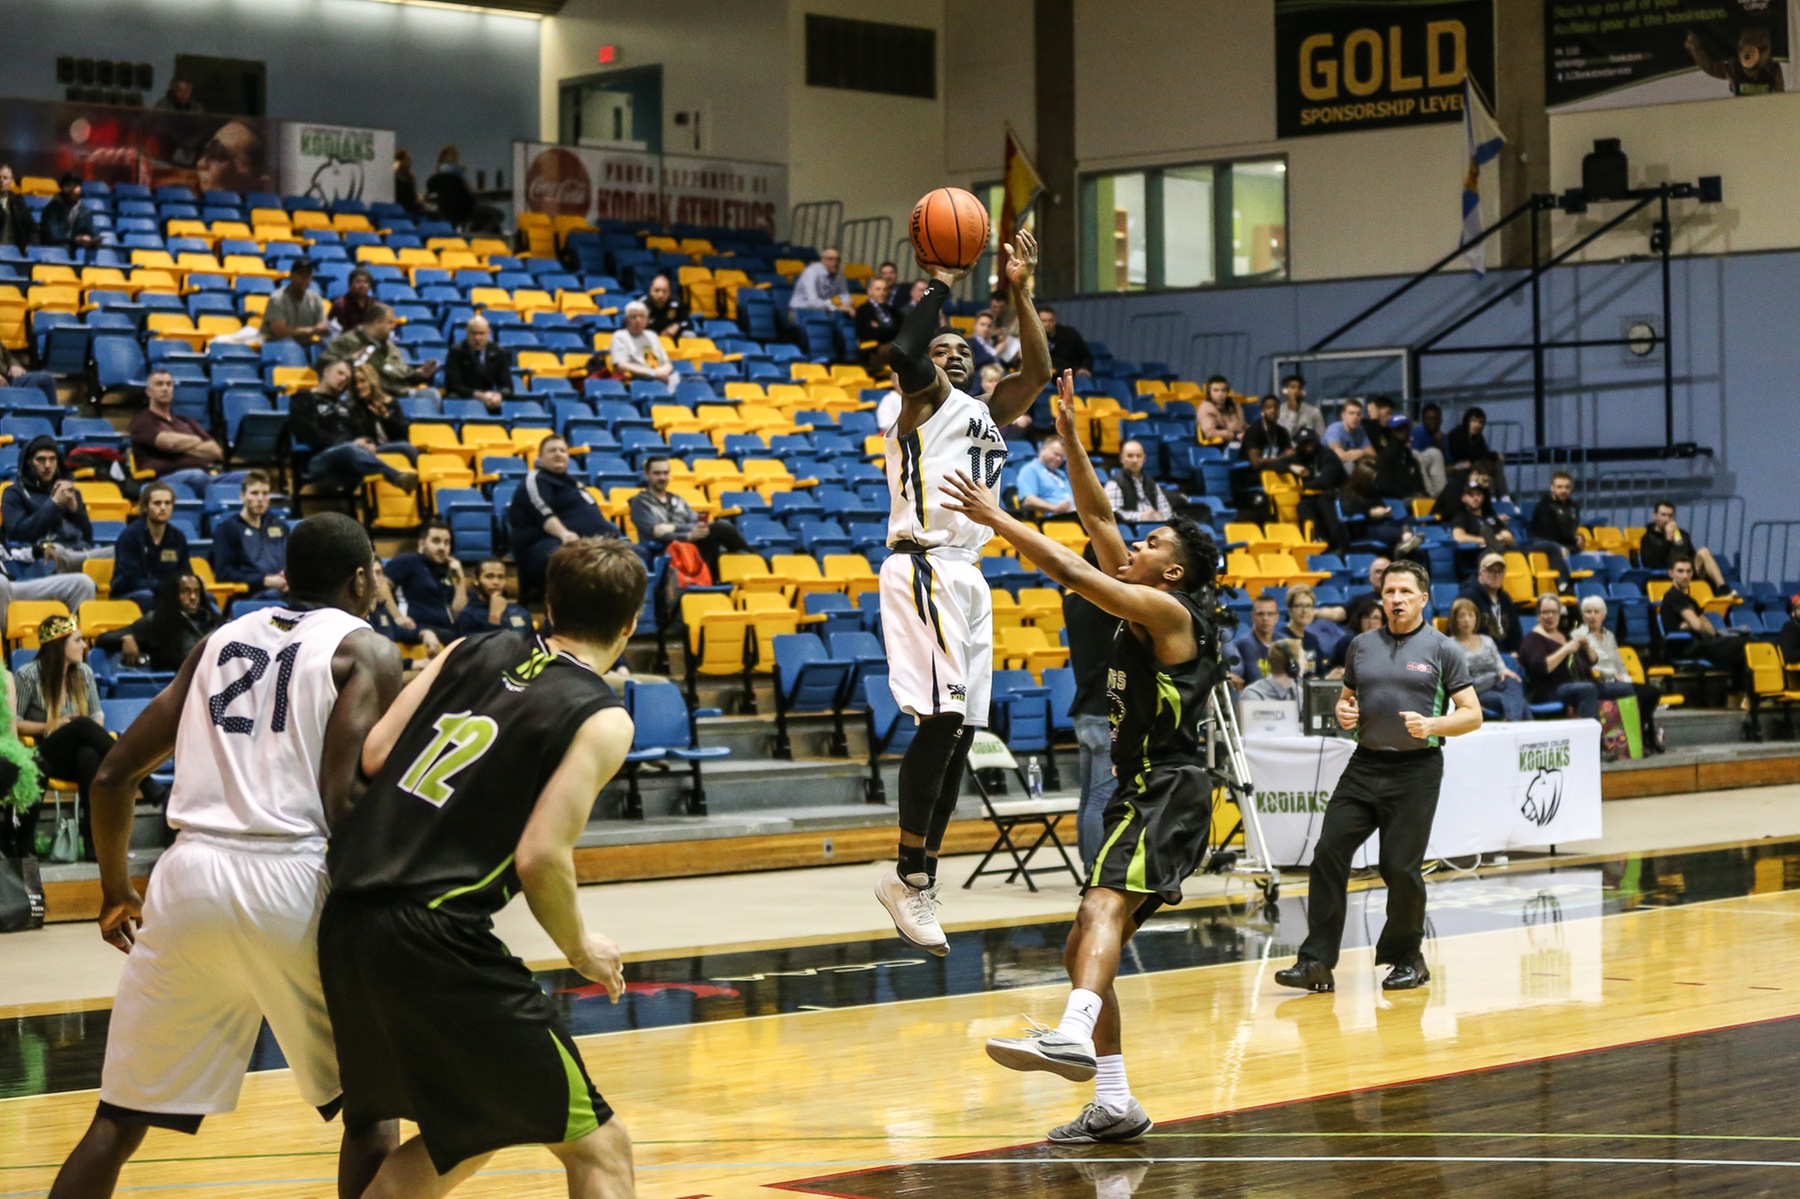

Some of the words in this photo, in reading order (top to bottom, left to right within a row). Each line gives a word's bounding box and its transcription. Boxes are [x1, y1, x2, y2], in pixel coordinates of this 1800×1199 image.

[1600, 19, 1625, 33] gear
[1628, 16, 1640, 28] at
[1644, 13, 1663, 25] the
[1299, 20, 1467, 101] GOLD
[1301, 98, 1415, 126] SPONSORSHIP
[676, 195, 776, 237] ATHLETICS
[209, 641, 302, 736] 21
[397, 709, 499, 808] 12
[1519, 746, 1570, 772] KODIAKS
[1255, 790, 1330, 814] KODIAKS
